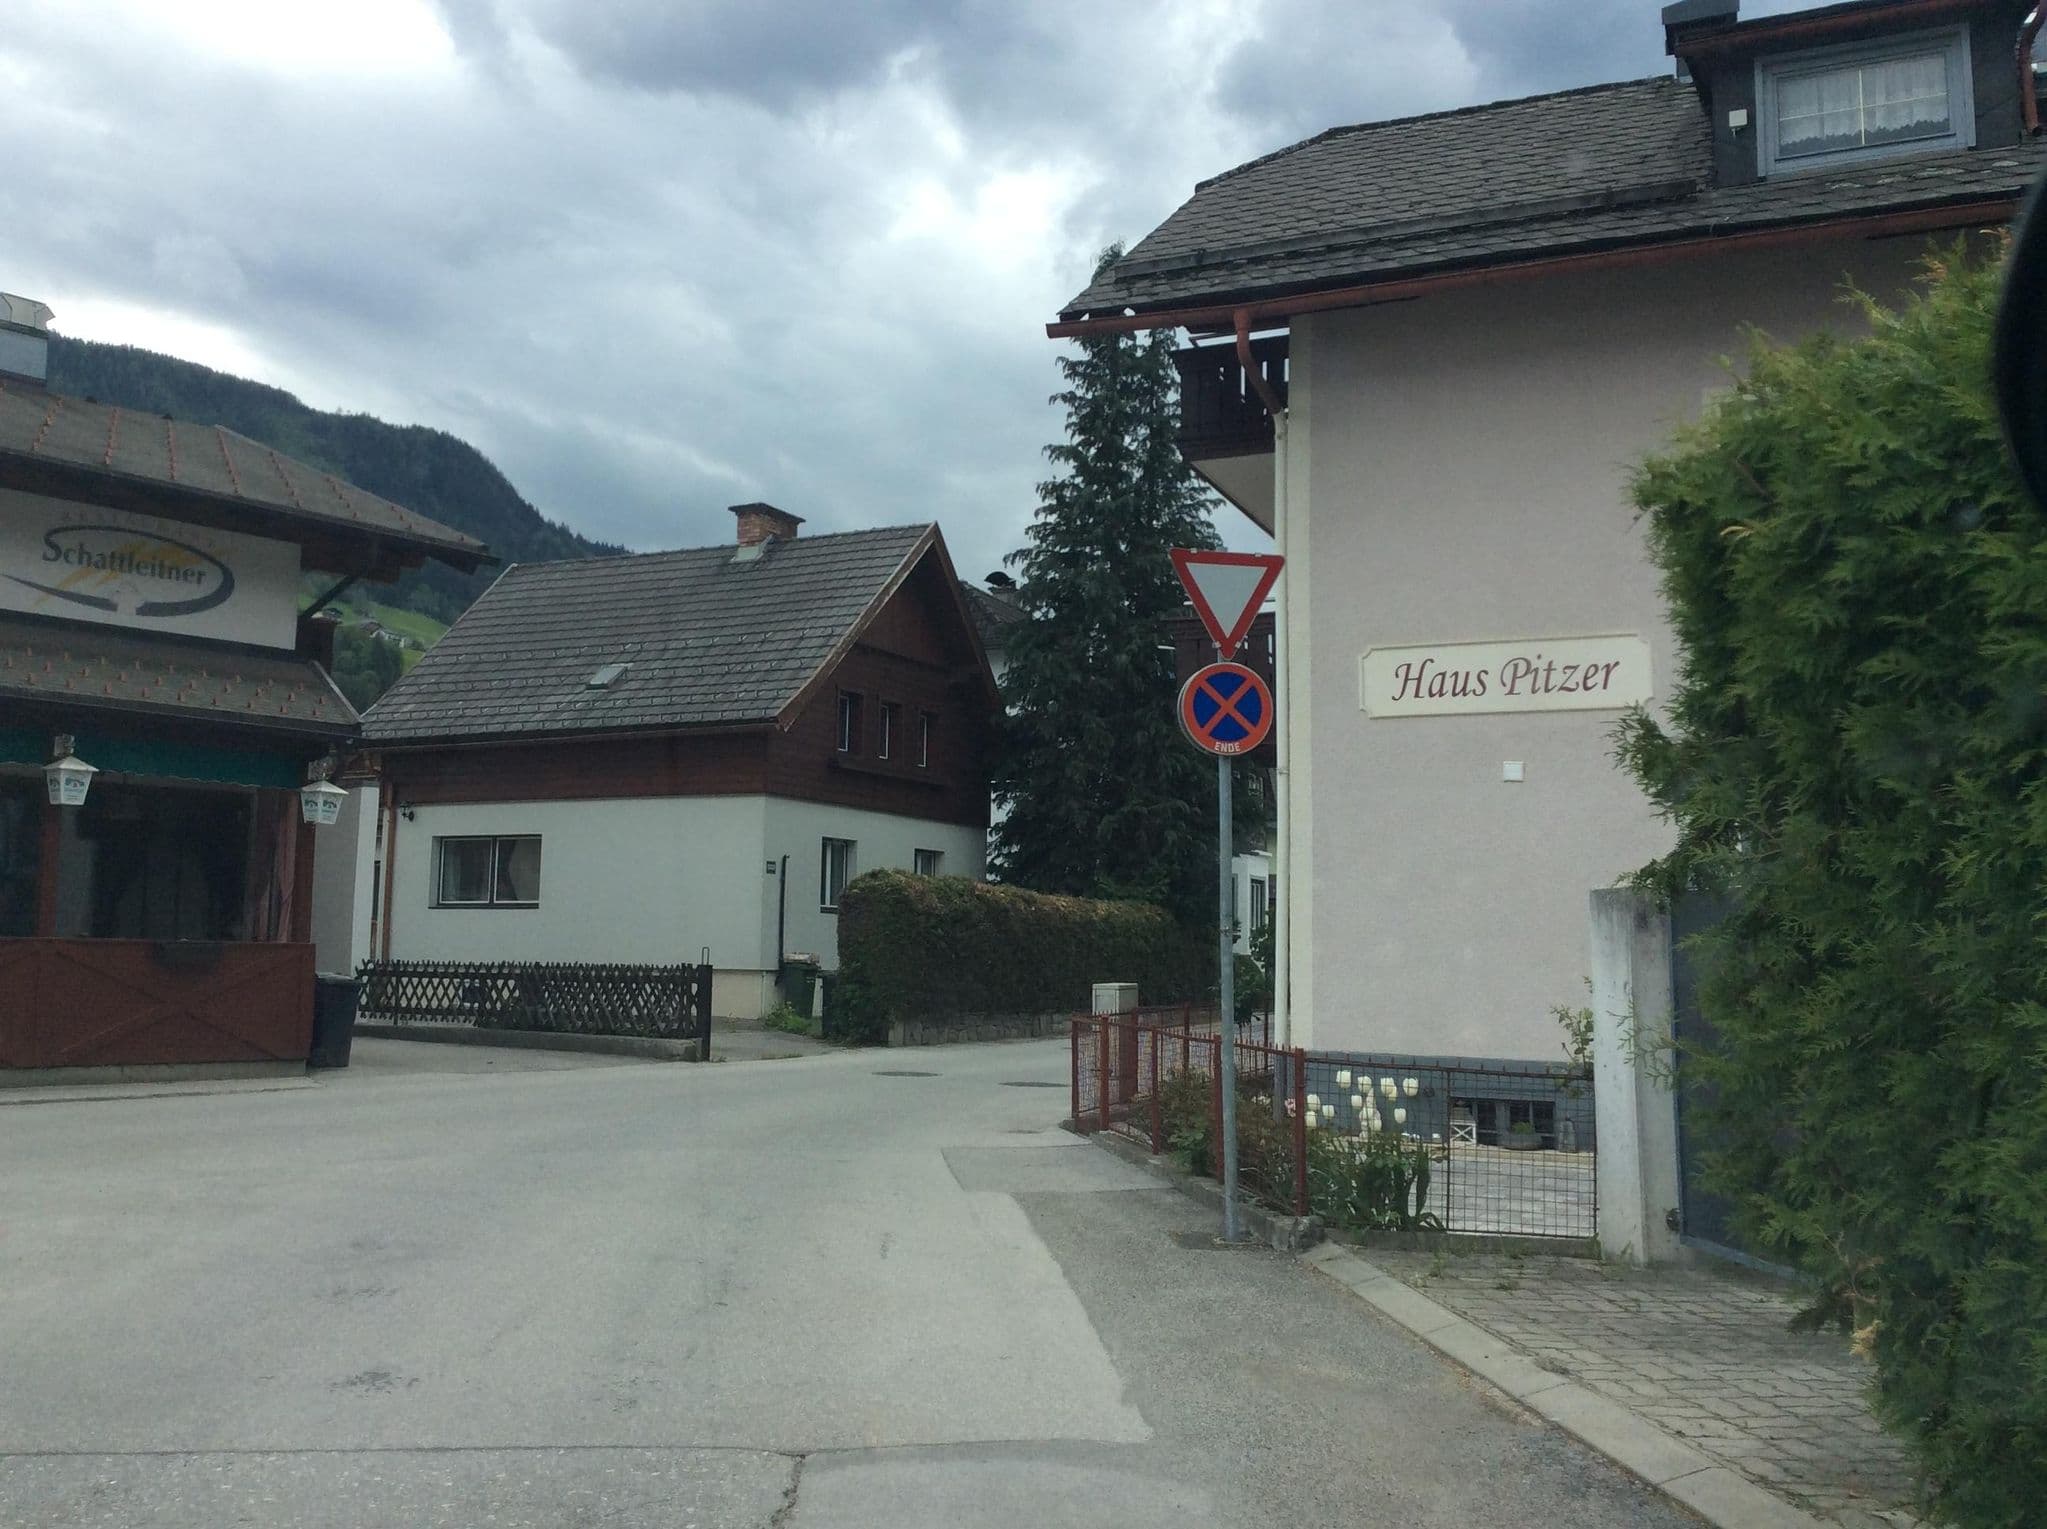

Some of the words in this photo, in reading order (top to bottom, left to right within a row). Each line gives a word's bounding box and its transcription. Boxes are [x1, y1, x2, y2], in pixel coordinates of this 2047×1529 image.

[42, 532, 207, 585] Schattleitner
[1391, 658, 1490, 701] Haus
[1500, 654, 1620, 697] Pitzer
[1214, 741, 1241, 753] ENDE
